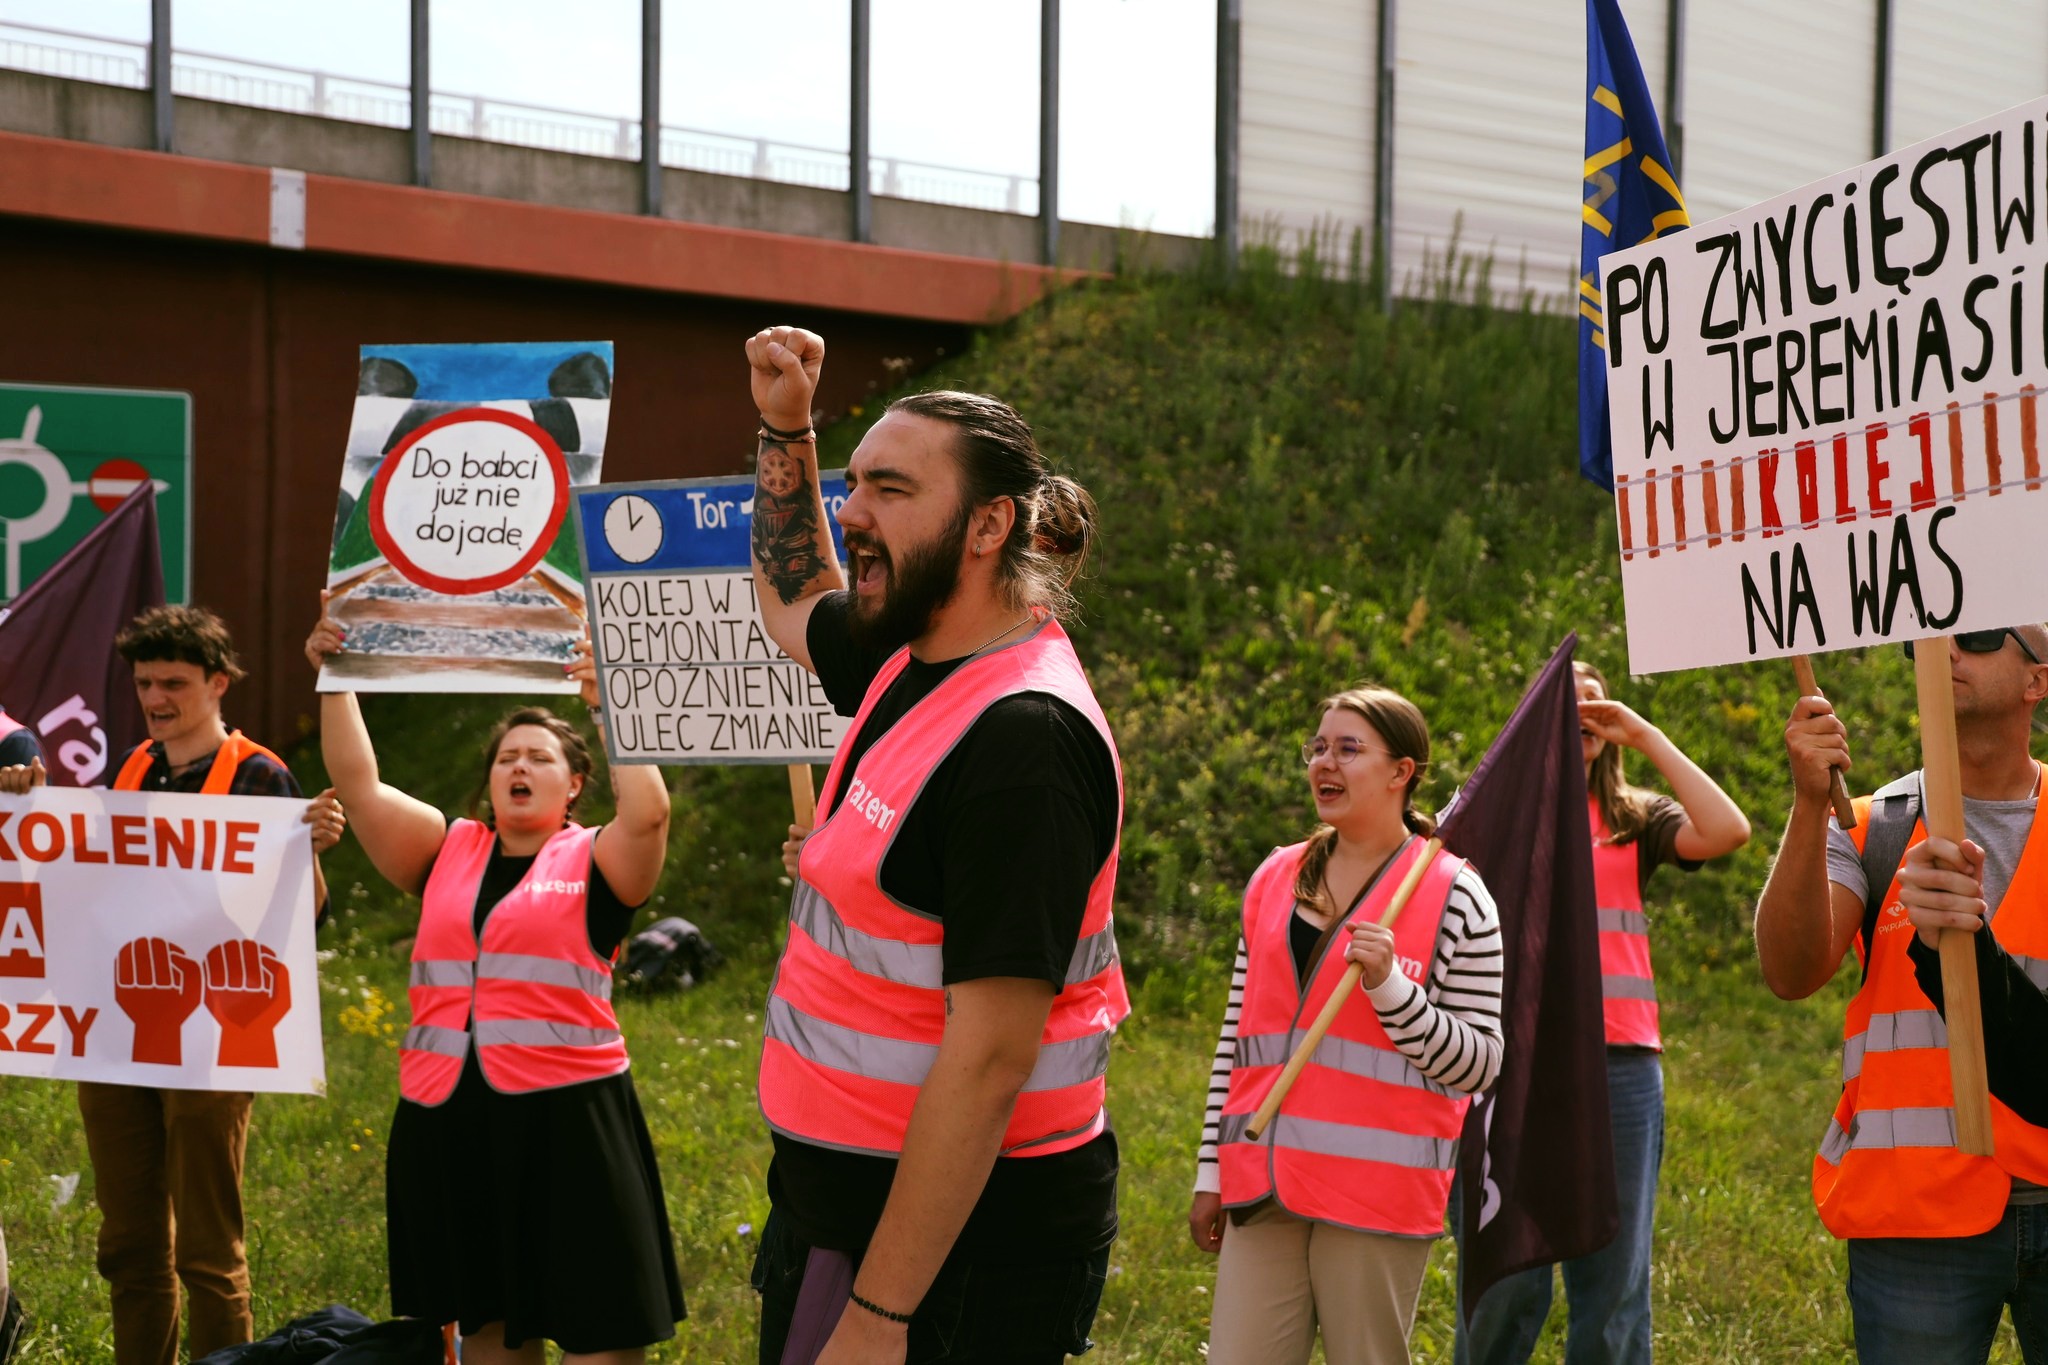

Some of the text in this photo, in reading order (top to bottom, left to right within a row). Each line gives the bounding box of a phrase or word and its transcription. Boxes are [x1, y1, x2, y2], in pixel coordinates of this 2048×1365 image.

[1607, 257, 1670, 368] PO
[1642, 359, 1674, 459] W
[412, 448, 538, 480] Do babci
[1757, 412, 1936, 539] KOLEJ
[432, 481, 520, 513] już nie
[687, 492, 734, 530] Tor
[416, 514, 523, 556] dojadę
[597, 579, 694, 618] KOLEJ
[705, 578, 731, 614] W
[1741, 506, 1963, 654] NA WAS
[602, 620, 789, 663] DEMONTA
[37, 693, 107, 791] ra
[616, 712, 835, 751] ULEC ZMIANIE
[846, 776, 896, 833] razem
[523, 879, 586, 895] razem
